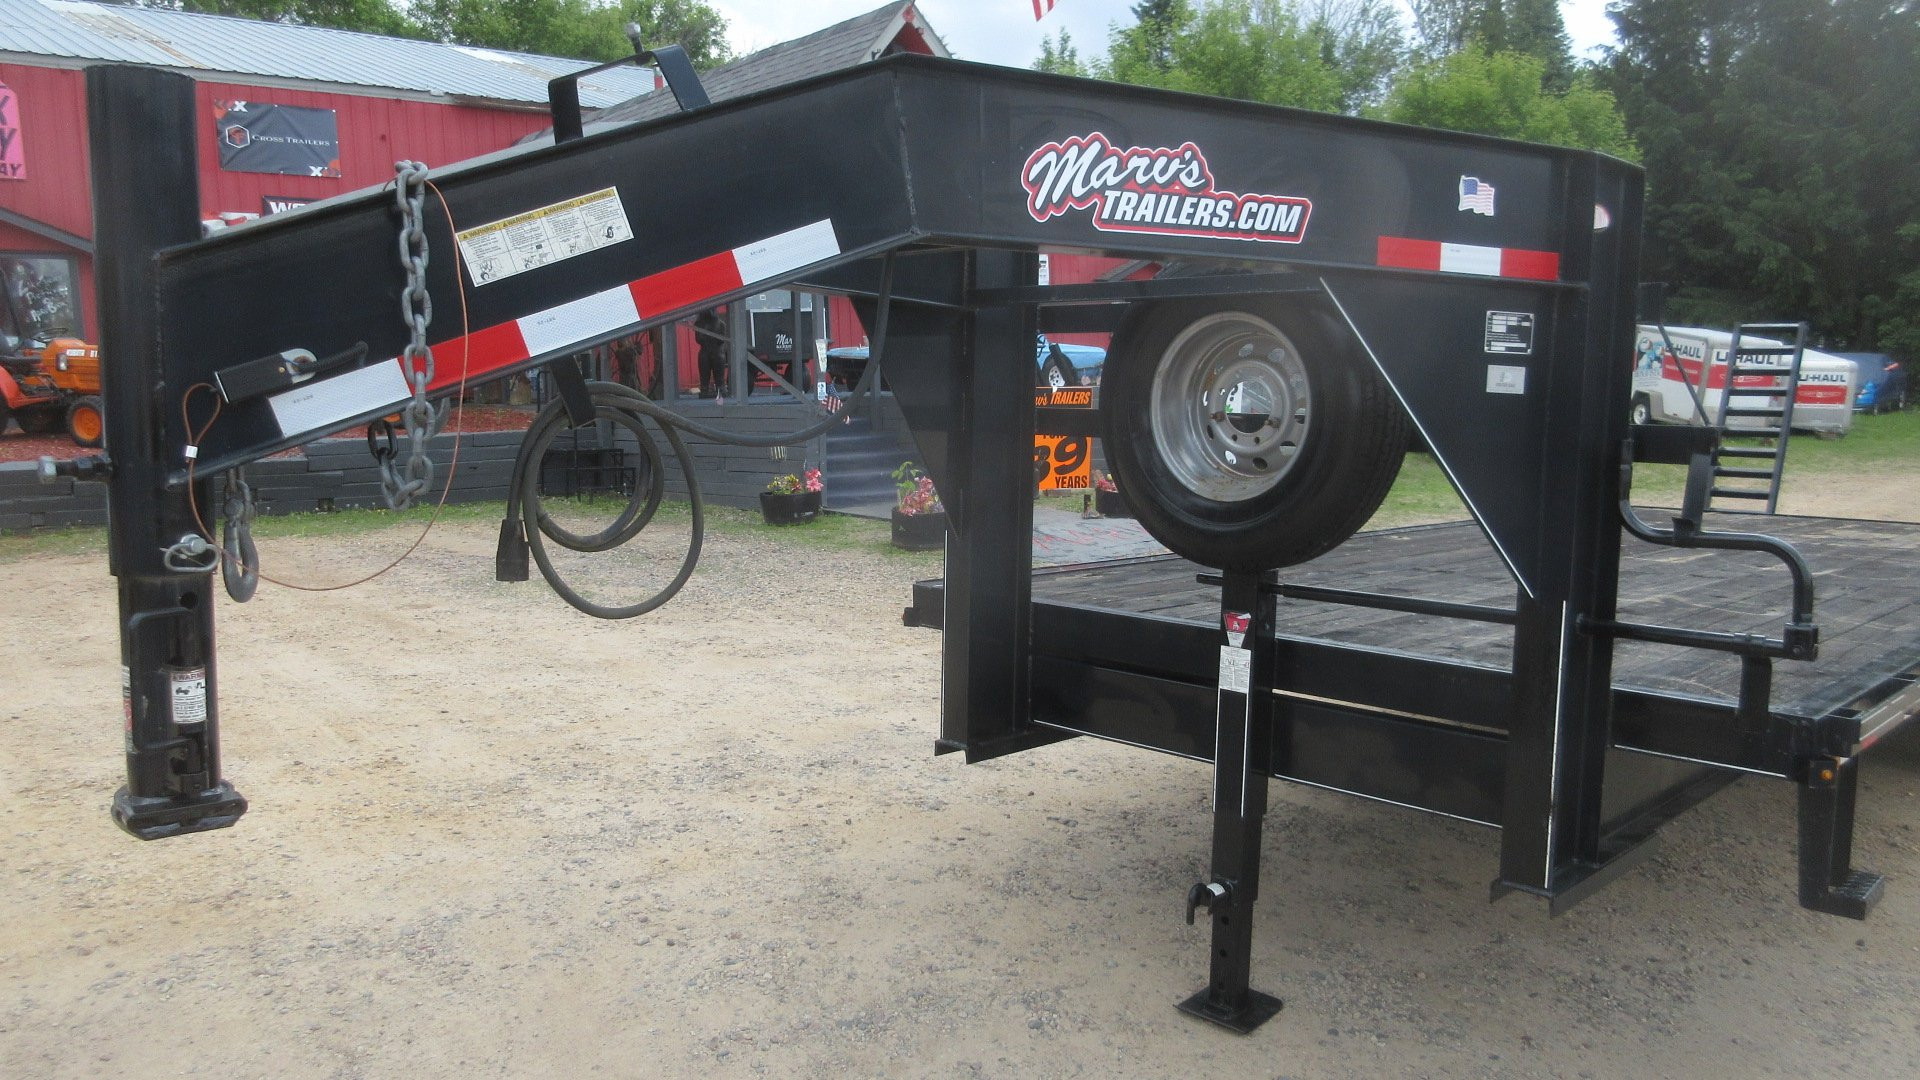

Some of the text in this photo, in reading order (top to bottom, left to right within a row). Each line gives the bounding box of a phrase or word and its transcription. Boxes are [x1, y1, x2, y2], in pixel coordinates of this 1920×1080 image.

[1029, 141, 1205, 209] Marv's
[1101, 190, 1303, 233] TRAILERS.COM
[1050, 391, 1091, 405] TRAILERS
[1055, 476, 1087, 488] YEARS
